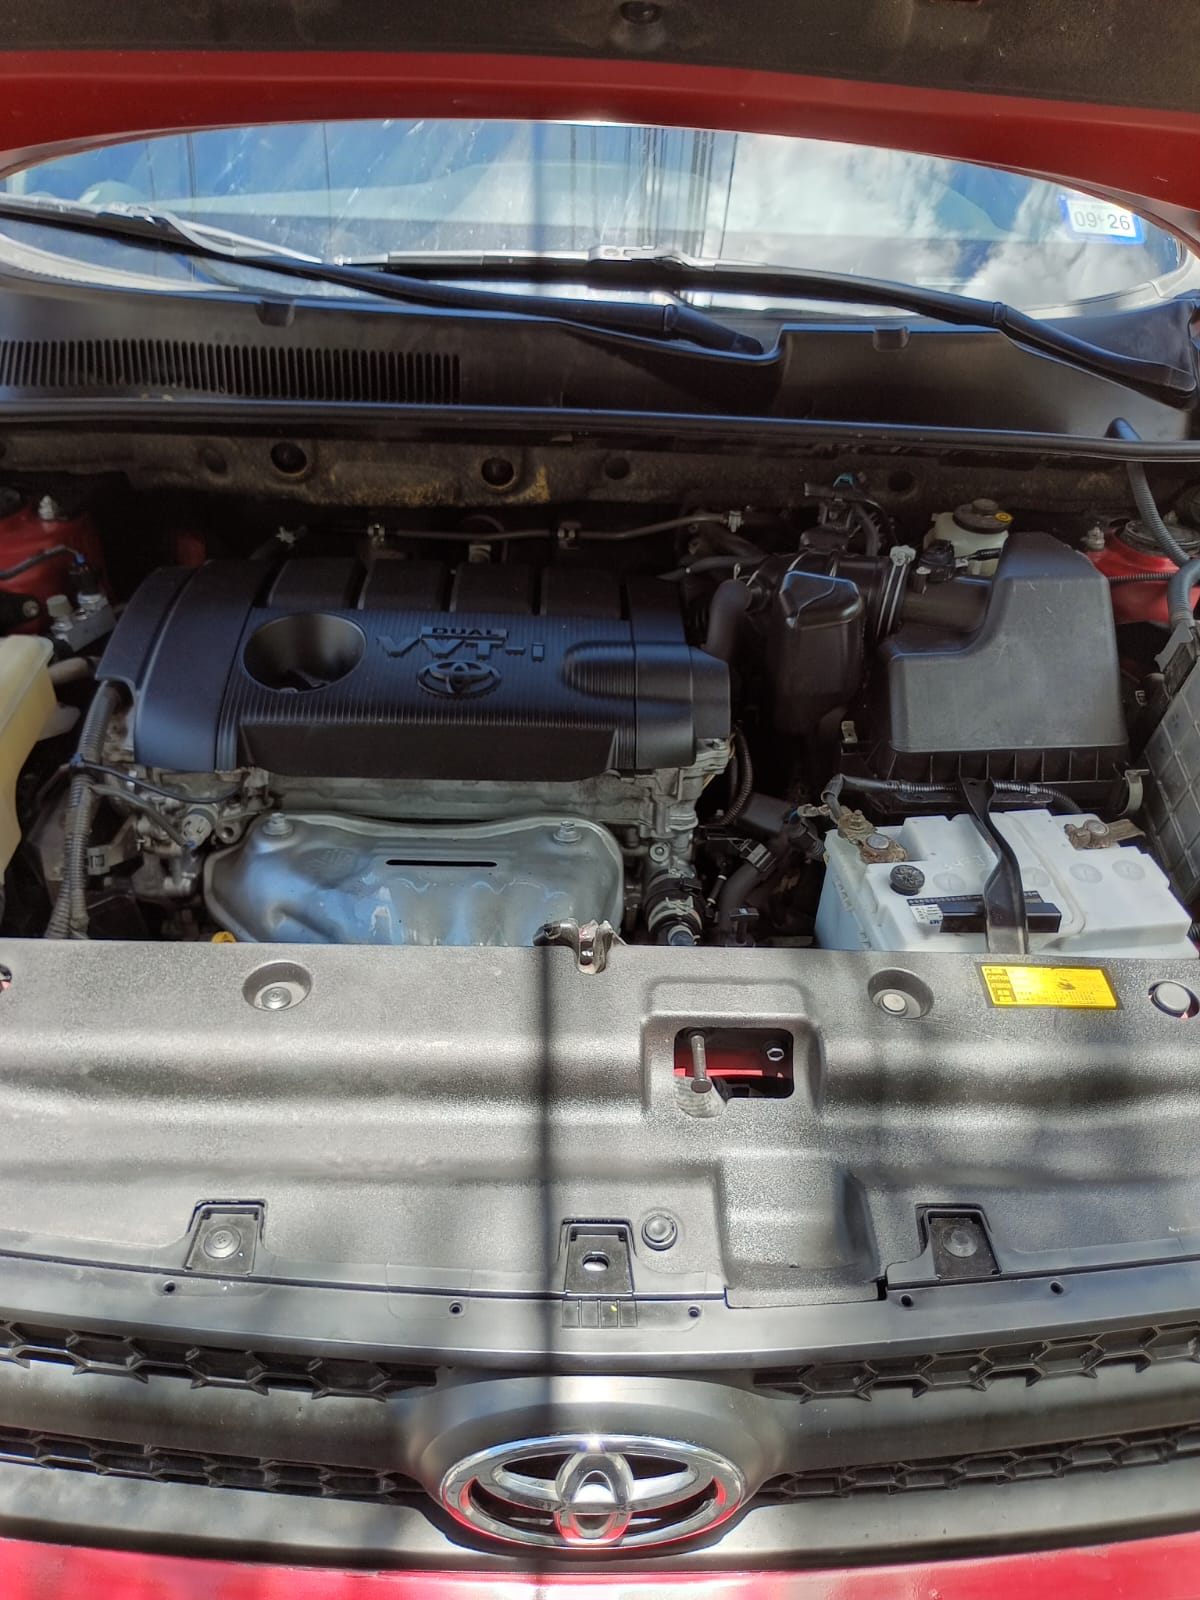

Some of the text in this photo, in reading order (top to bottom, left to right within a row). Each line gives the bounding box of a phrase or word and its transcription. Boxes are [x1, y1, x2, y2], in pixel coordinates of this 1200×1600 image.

[1074, 211, 1131, 231] 09 26
[430, 626, 500, 637] DUAL
